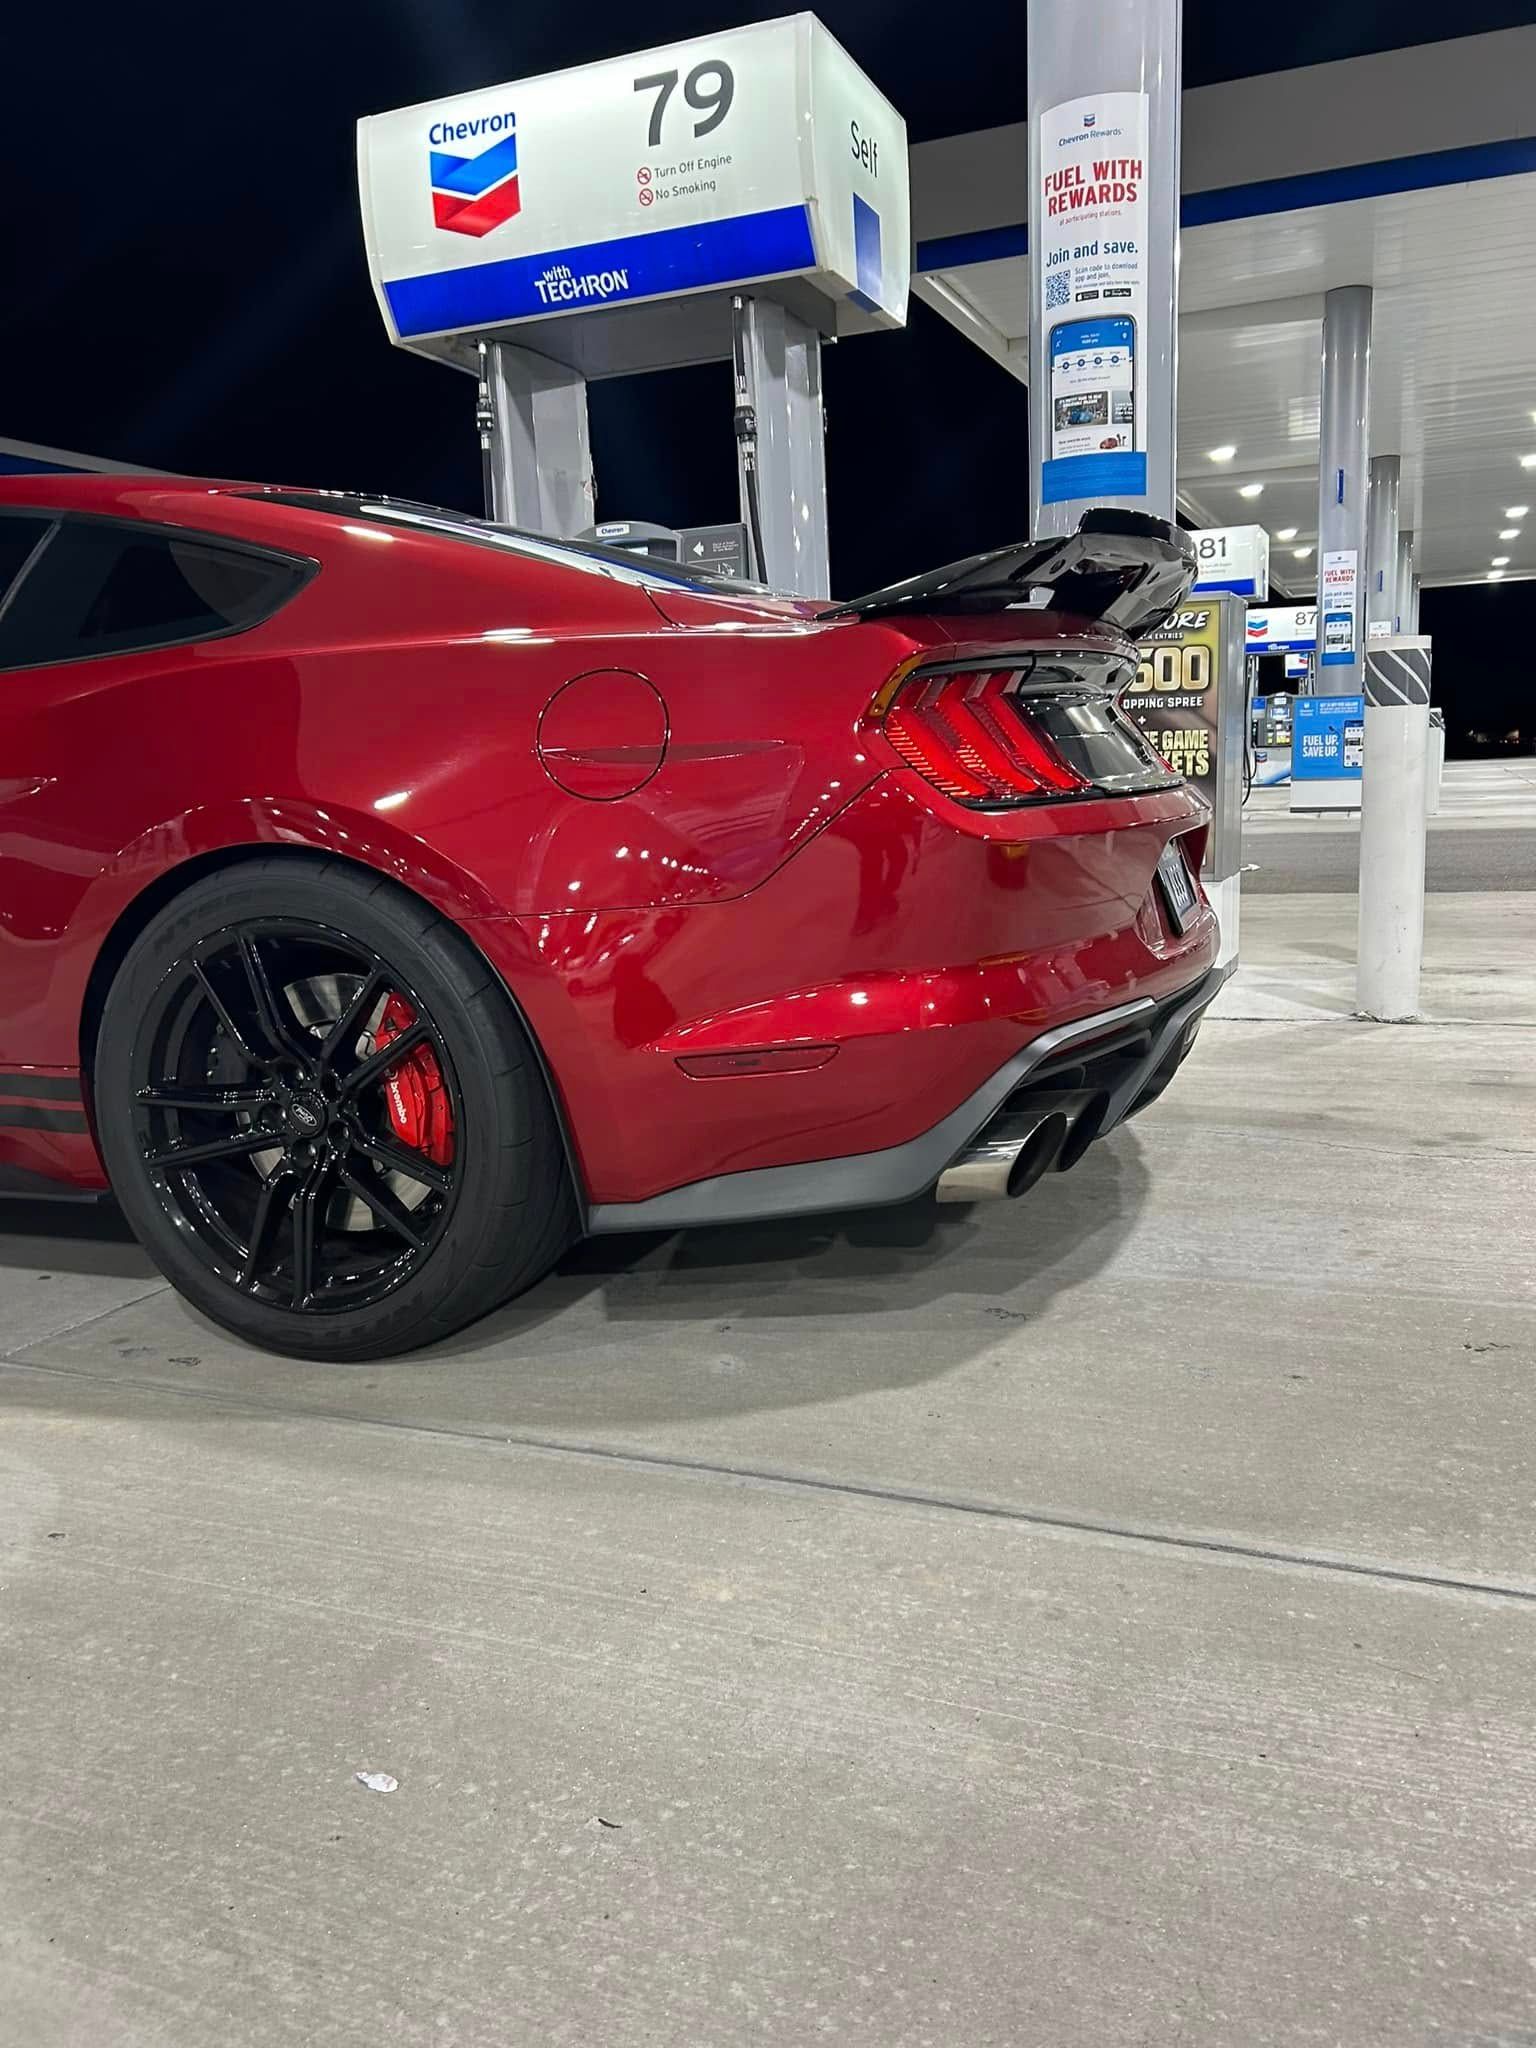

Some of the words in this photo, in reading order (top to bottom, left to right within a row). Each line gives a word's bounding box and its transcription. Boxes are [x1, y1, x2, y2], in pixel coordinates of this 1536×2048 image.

[633, 59, 735, 147] 79
[429, 111, 516, 145] Chevron
[1058, 132, 1089, 147] Chevron
[1089, 128, 1122, 139] Rewards
[850, 120, 878, 178] Self
[654, 166, 677, 178] Turn
[679, 160, 694, 174] Off
[697, 155, 733, 169] Engine
[1044, 165, 1086, 197] FUEL
[1093, 159, 1142, 181] WITH
[655, 189, 670, 200] No
[672, 180, 717, 197] Smoking
[1048, 182, 1138, 217] REWARDS
[1046, 247, 1070, 267] Join
[1073, 240, 1098, 259] and
[1103, 241, 1138, 254] save.
[542, 264, 572, 282] with
[534, 269, 629, 304] TECHRON
[1199, 536, 1226, 559] 81
[1162, 611, 1210, 630] ORE
[1295, 611, 1319, 626] 87
[1123, 697, 1164, 709] OPPING
[1167, 696, 1203, 707] SPREE
[1161, 729, 1209, 751] GAME
[1302, 746, 1322, 757] SAVE
[1324, 745, 1339, 757] UP.
[1303, 735, 1324, 746] FUEL
[1325, 734, 1339, 746] UP.
[390, 1081, 408, 1124] brembo
